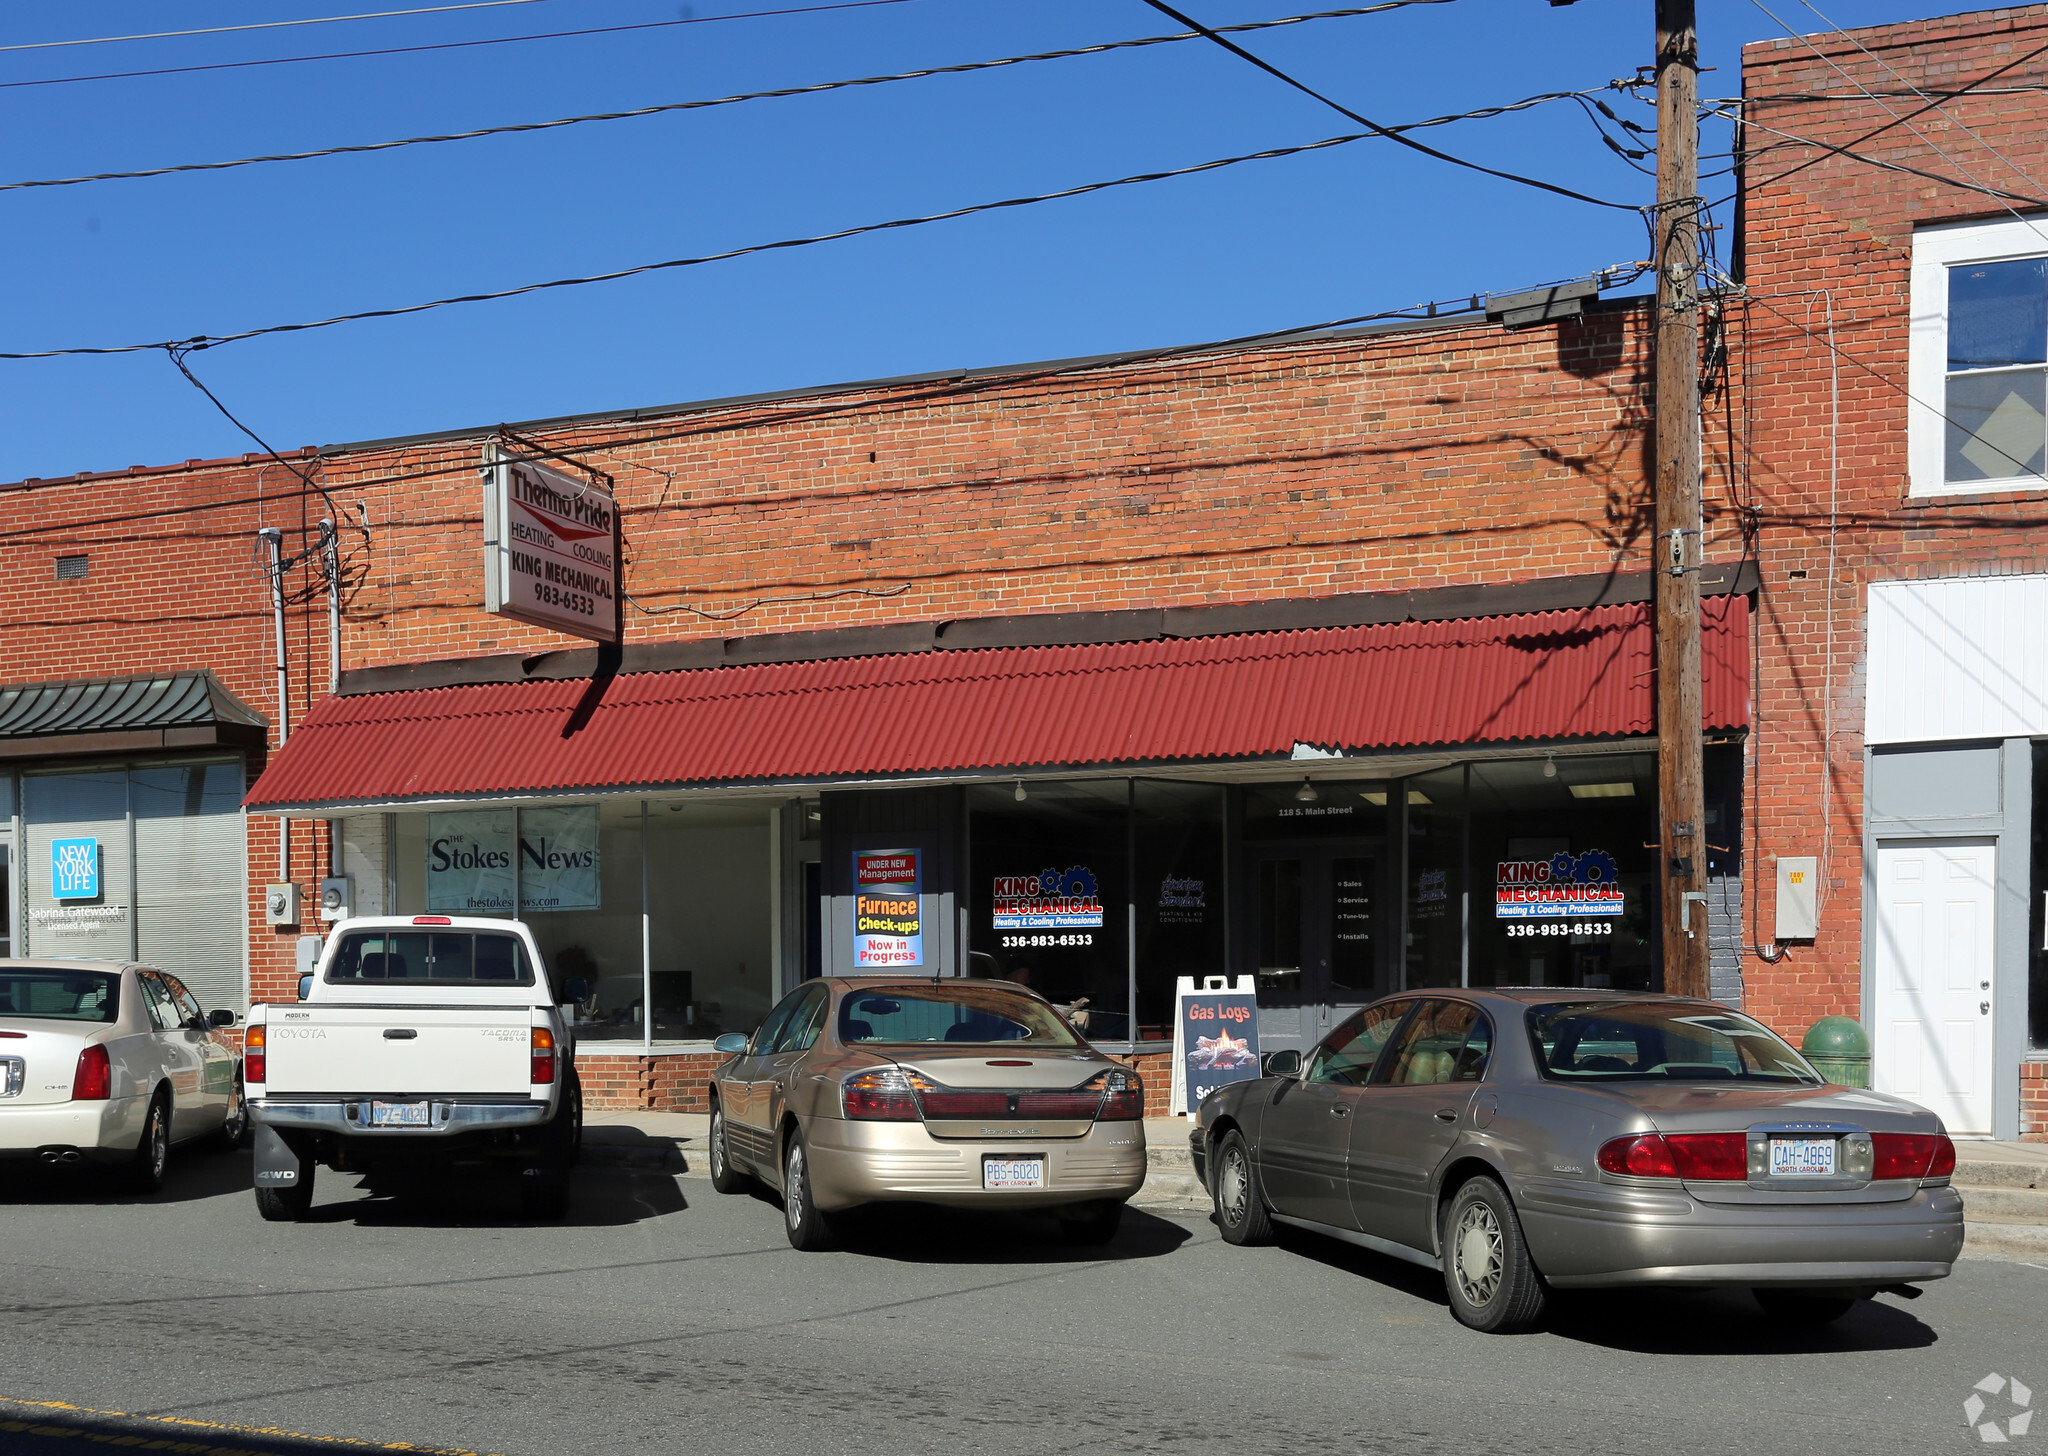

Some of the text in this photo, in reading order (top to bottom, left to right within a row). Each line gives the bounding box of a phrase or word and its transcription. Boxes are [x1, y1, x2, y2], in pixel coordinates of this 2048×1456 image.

[511, 468, 611, 533] Thermo Pride
[511, 521, 554, 548] HEATING
[573, 543, 611, 568] COOLING
[512, 551, 612, 600] KING MECHANICAL
[534, 582, 594, 616] 983-6533
[1305, 807, 1325, 815] Main
[1327, 806, 1353, 814] Street
[450, 835, 464, 843] THE
[60, 845, 91, 861] NEW
[431, 837, 593, 872] Stokes News
[54, 859, 95, 876] YORK
[866, 859, 906, 869] UNDER NEW
[1497, 861, 1550, 883] KING
[859, 868, 915, 880] Management
[61, 875, 91, 891] LIFE
[994, 876, 1040, 897] KING
[1497, 882, 1624, 903] MECHANICAL
[29, 905, 119, 918] Sabrina Gatewood
[857, 896, 917, 916] Furnace
[994, 896, 1104, 915] MECHANICAL
[1498, 903, 1622, 916] Heating & Cooling Professionals
[47, 921, 100, 931] Licensed Agent
[858, 917, 919, 935] Check-ups
[995, 915, 1102, 928] Heating & Cooling Professionals
[1507, 923, 1613, 937] 336-983-6533
[868, 939, 907, 951] Now in
[1002, 934, 1093, 948] 336-983-6533
[860, 951, 916, 964] Progress
[1188, 1003, 1251, 1023] Gas Logs
[270, 1028, 327, 1039] TOYOTA
[373, 1106, 427, 1123] NPZ-4020
[1774, 1146, 1832, 1165] CAH-4869
[257, 1170, 295, 1179] 4WD
[987, 1163, 1039, 1180] PBS-6020
